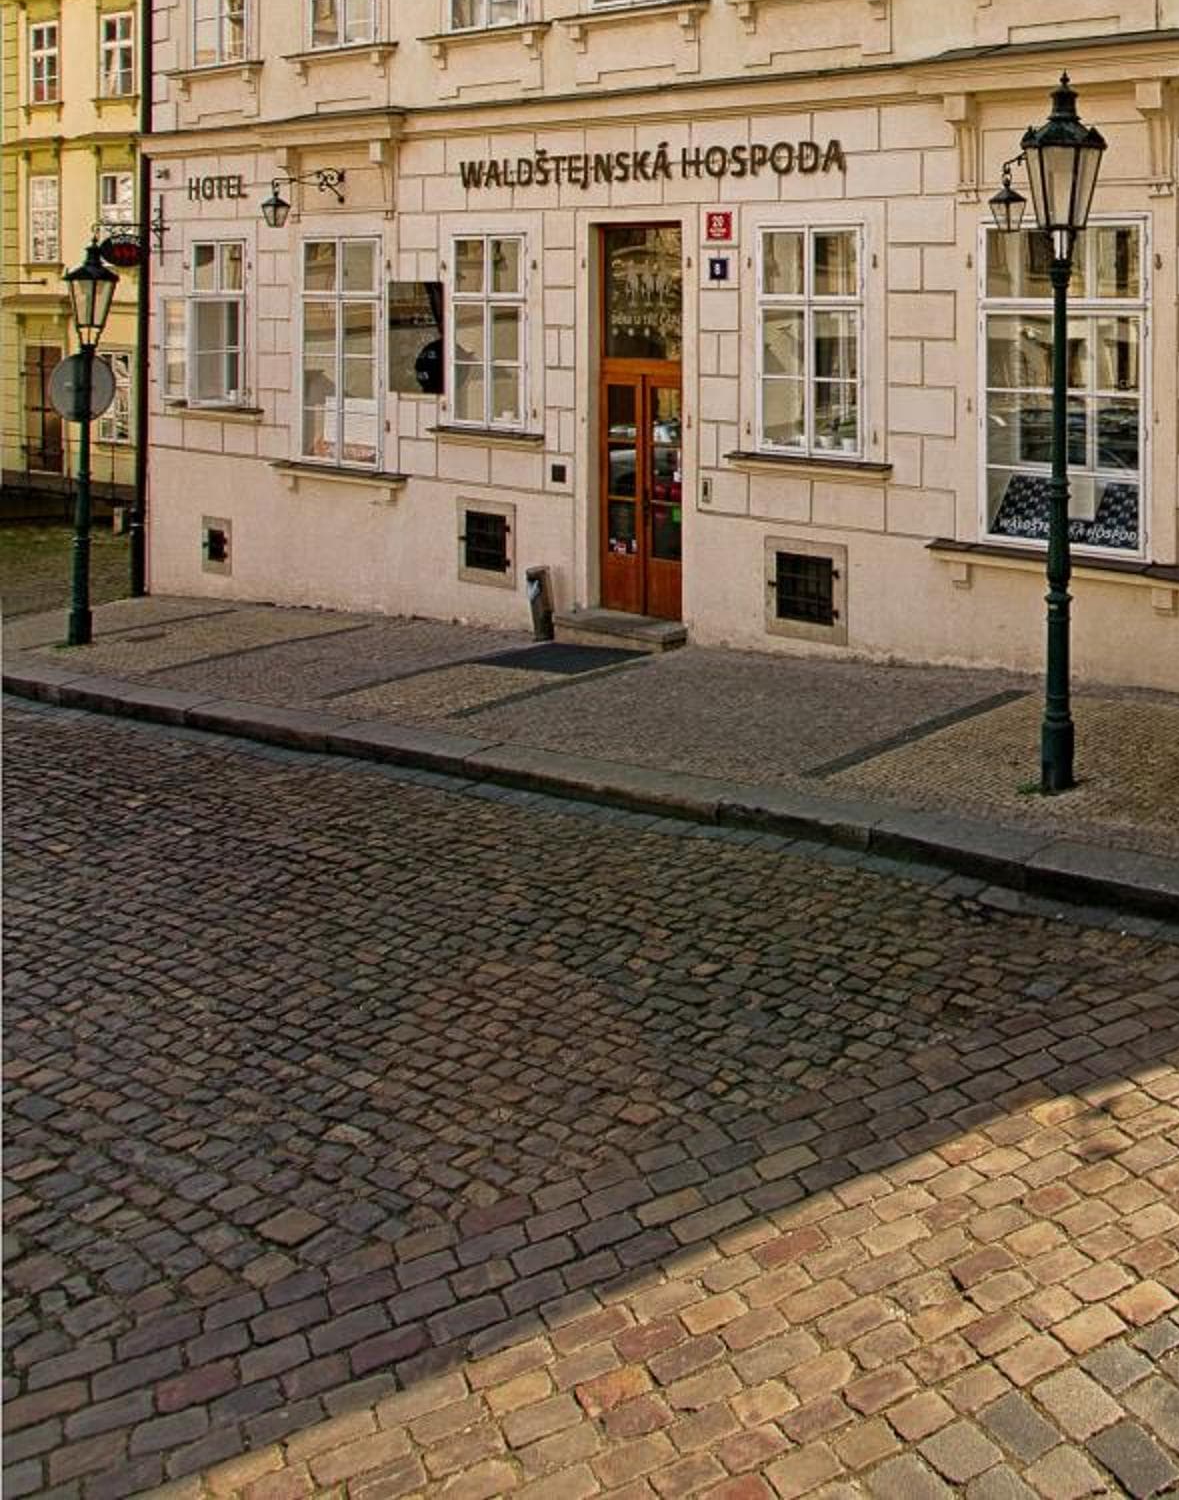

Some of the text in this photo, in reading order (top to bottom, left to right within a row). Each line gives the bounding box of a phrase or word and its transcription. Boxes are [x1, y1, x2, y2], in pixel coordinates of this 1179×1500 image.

[460, 139, 846, 190] WALDŠTEJNSKÁ HOSPODA
[188, 174, 248, 201] HOTEL
